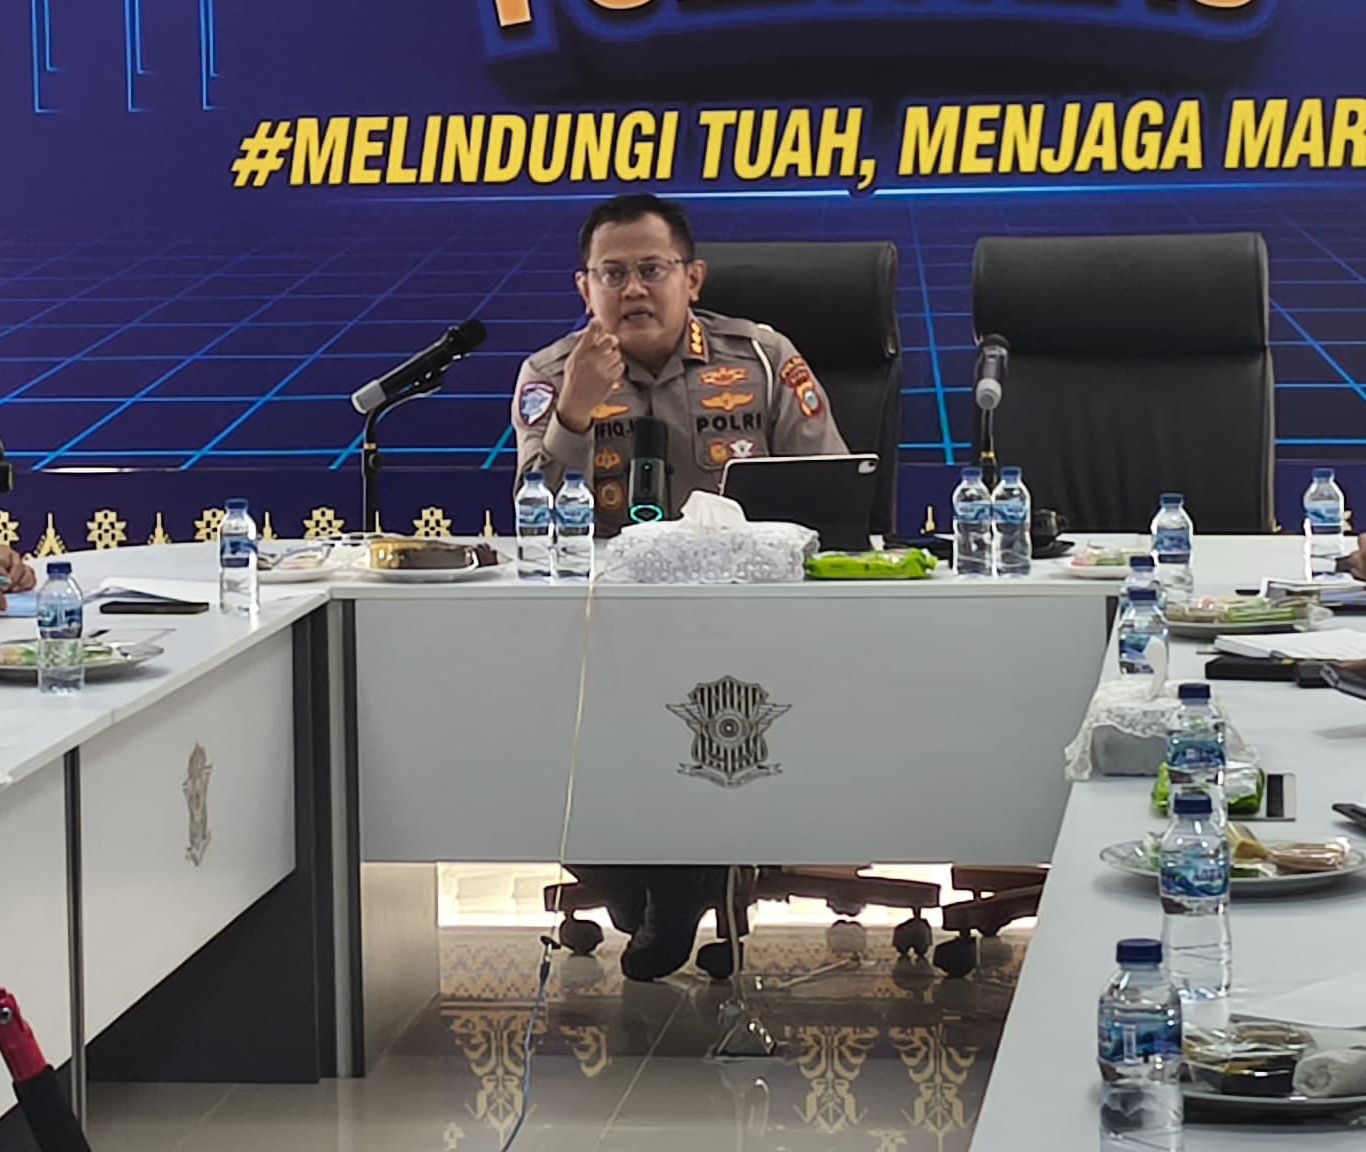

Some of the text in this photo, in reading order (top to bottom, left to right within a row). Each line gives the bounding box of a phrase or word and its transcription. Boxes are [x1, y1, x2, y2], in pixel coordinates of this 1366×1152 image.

[231, 110, 678, 187] #MELINDUNGI
[698, 107, 877, 189] TUAH,
[898, 99, 1204, 176] MENJAGA
[696, 412, 762, 433] POLRI
